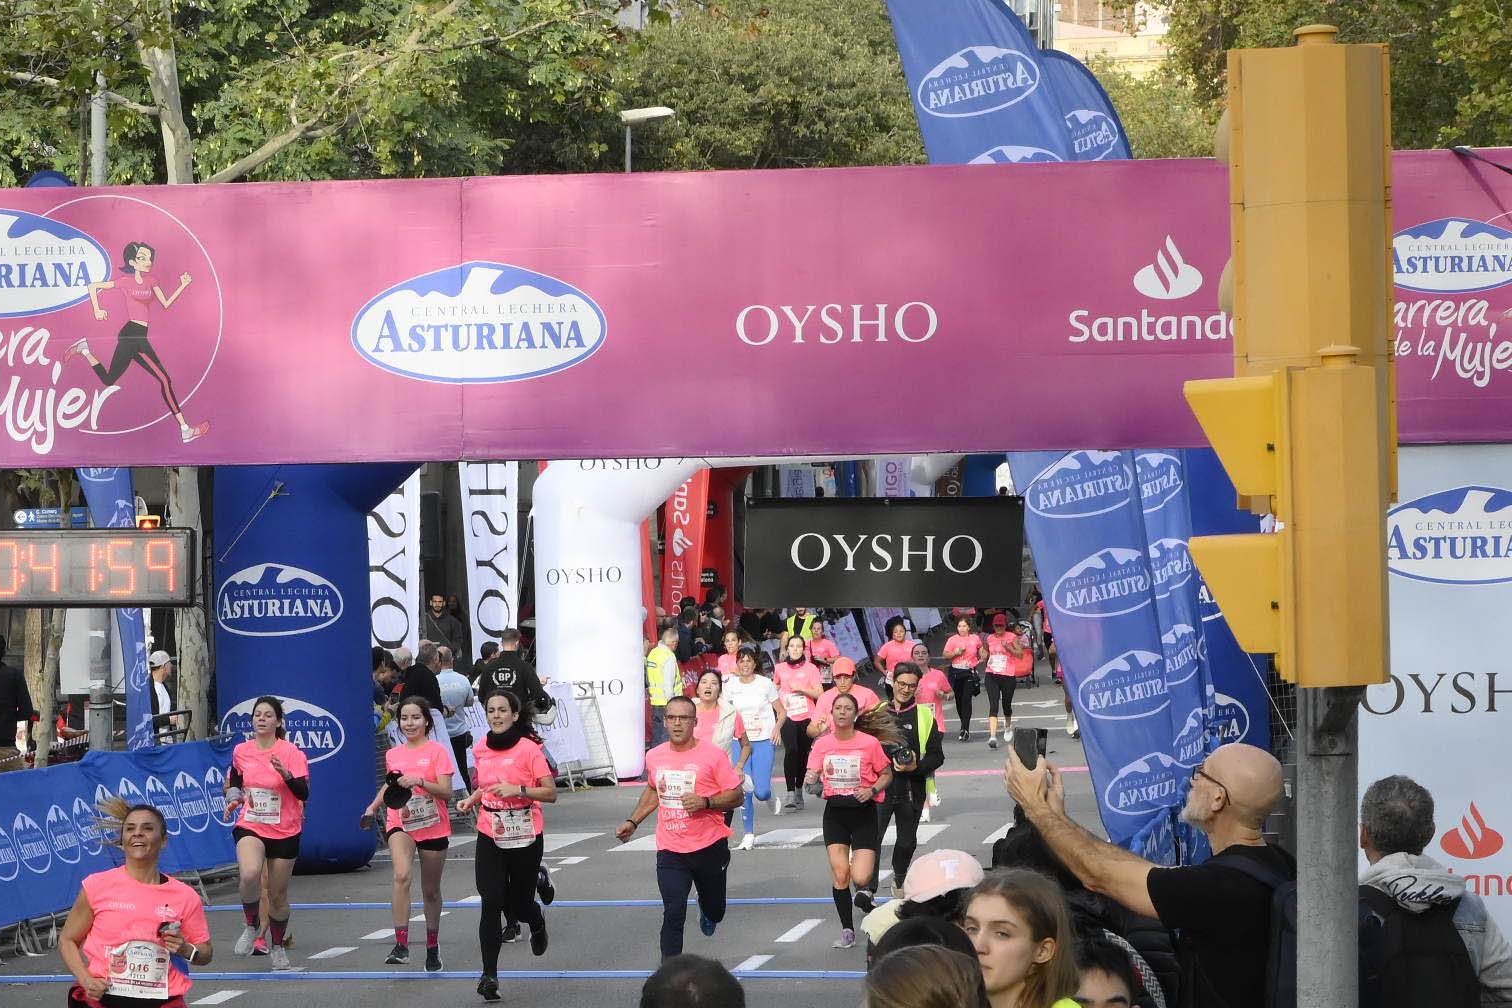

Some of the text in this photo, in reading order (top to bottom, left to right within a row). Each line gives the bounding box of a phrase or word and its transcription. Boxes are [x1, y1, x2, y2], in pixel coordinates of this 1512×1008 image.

[13, 245, 86, 257] LECHERA
[1408, 243, 1512, 252] CENTRAL LECHER
[411, 303, 579, 318] CENTRAL LECHERA
[1394, 299, 1490, 328] arrera
[371, 309, 587, 353] ASTURIANA
[735, 301, 939, 345] OYSHO
[1068, 309, 1236, 343] Santand
[1418, 329, 1435, 356] la
[1431, 323, 1512, 388] Muje
[1415, 521, 1482, 531] CENTRAL
[790, 532, 984, 574] OYSHO
[1388, 524, 1512, 560] ASTURI
[546, 566, 623, 585] OYSHO
[233, 588, 329, 597] CENTRAL LECHERA
[221, 593, 334, 620] ASTURIANA
[498, 672, 511, 682] BP
[1363, 670, 1512, 717] OYSH
[288, 719, 331, 728] ECHERA
[129, 963, 149, 972] 016
